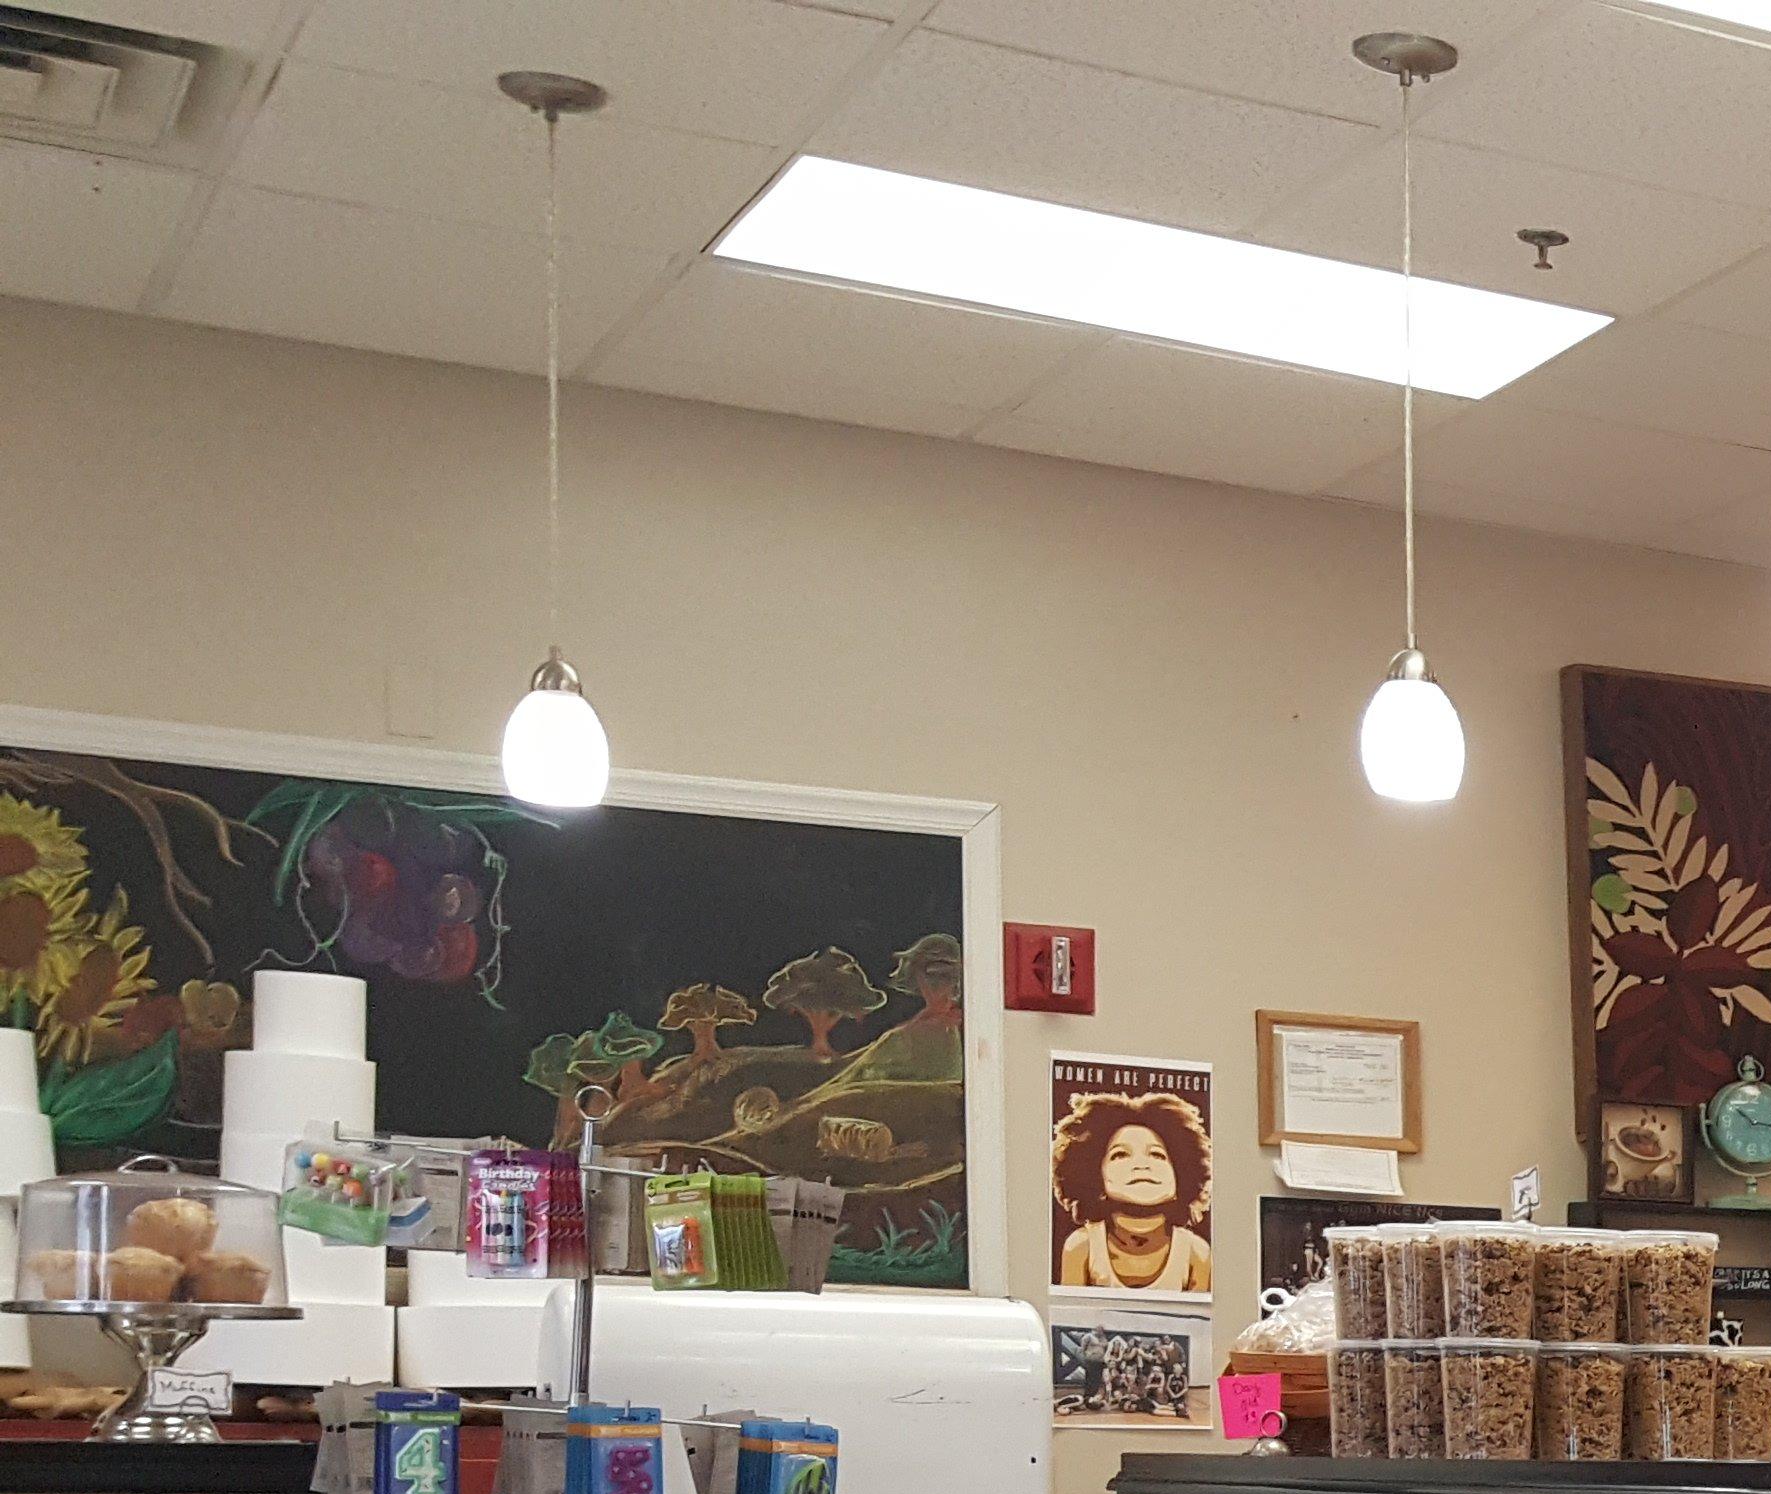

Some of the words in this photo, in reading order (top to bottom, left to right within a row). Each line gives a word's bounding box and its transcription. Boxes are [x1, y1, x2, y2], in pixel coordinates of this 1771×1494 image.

[1054, 1065, 1104, 1084] WOMEN
[1114, 1069, 1139, 1086] ARE
[1149, 1073, 1209, 1092] PERFECT
[479, 1168, 540, 1181] Birthday
